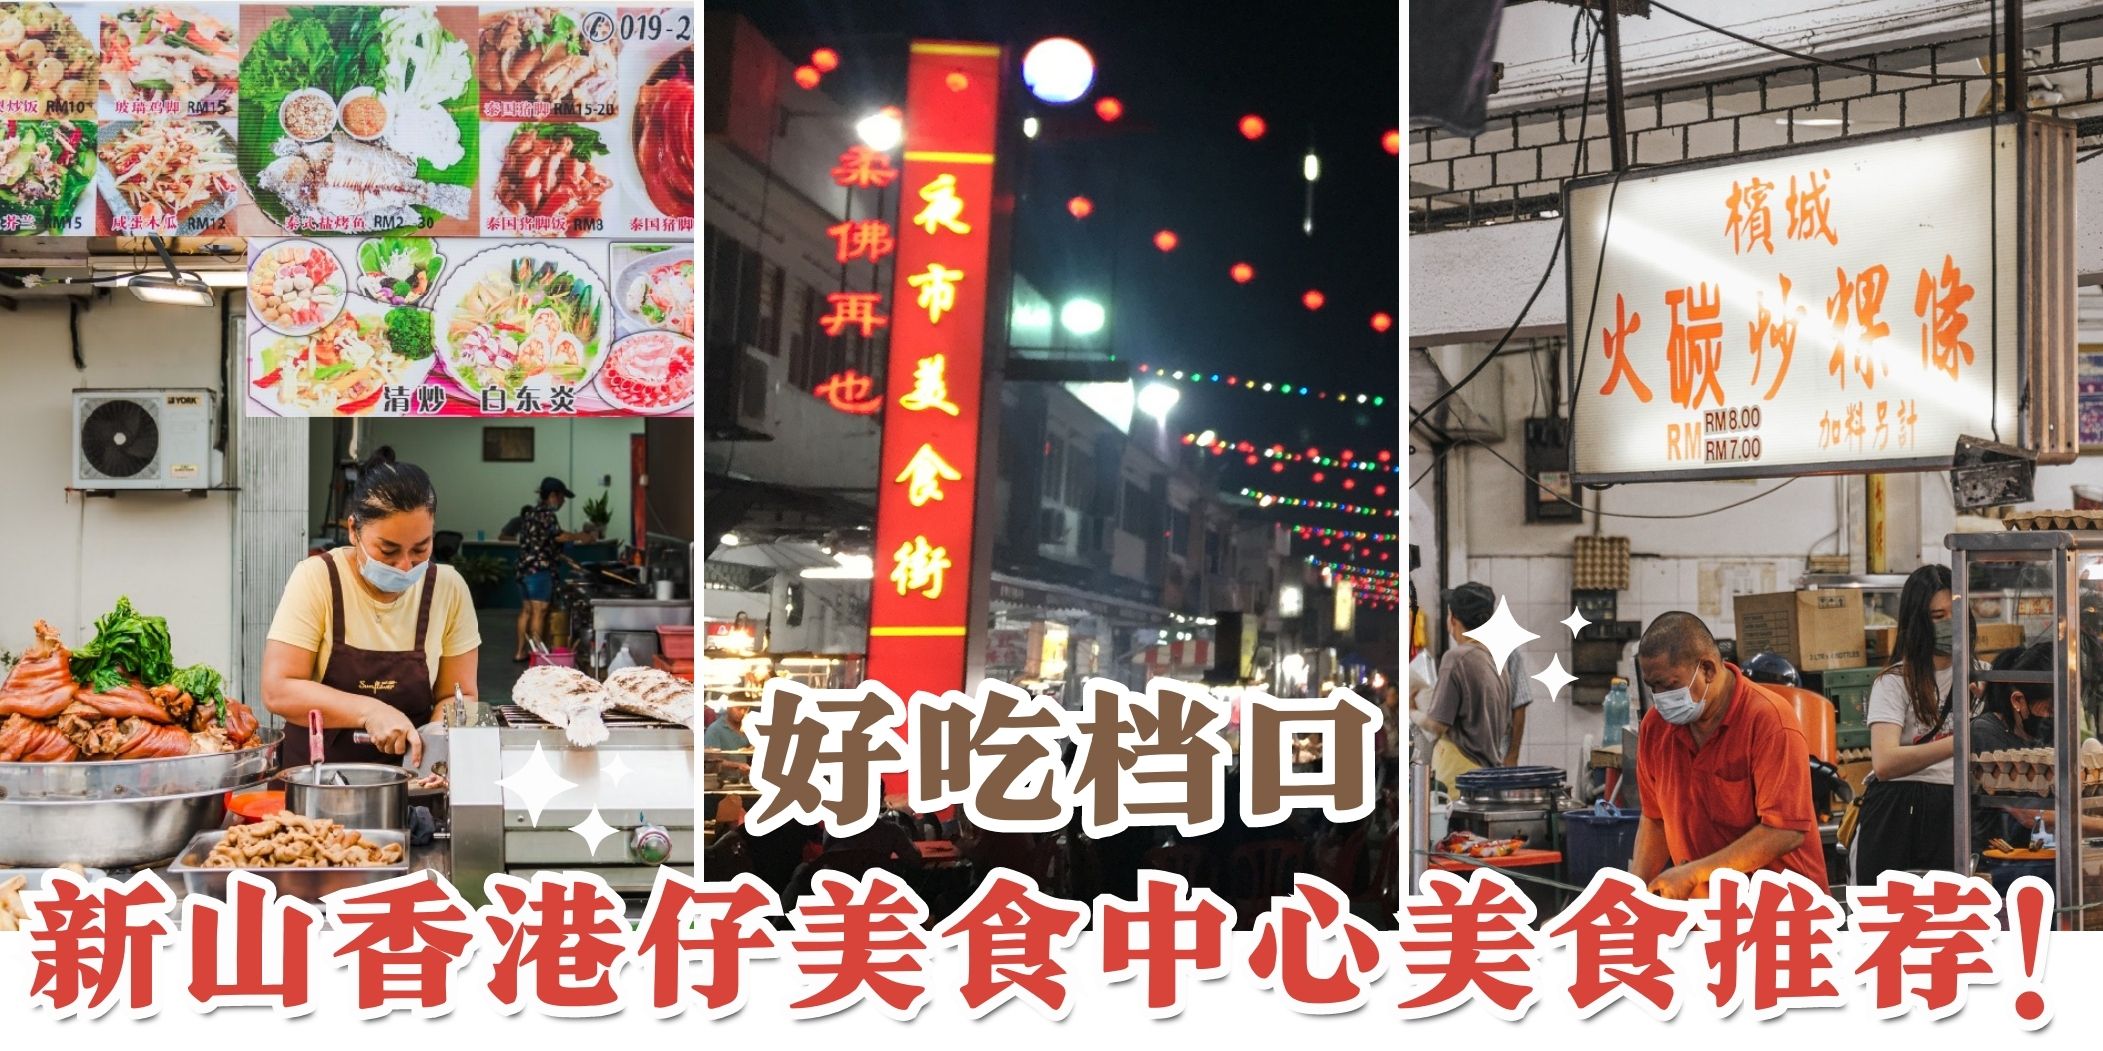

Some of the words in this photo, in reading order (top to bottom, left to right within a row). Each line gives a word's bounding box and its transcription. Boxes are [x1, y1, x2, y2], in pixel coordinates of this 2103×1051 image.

[46, 100, 86, 114] RM10
[188, 101, 227, 114] RM15
[483, 101, 549, 116] 泰国猪脚
[554, 103, 613, 116] RM15-20
[1725, 168, 1838, 254] 檳城
[188, 217, 225, 230] RM12
[487, 217, 567, 231] 泰国猪脚饭
[573, 218, 603, 231] RM8
[631, 217, 694, 231] 泰国猪脚
[814, 144, 898, 416] 柔佛再也
[1600, 255, 1975, 410] 火碳炒粿條
[889, 172, 971, 599] 夜市美食街
[384, 386, 444, 413] 清炒
[482, 386, 575, 413] 白东炎
